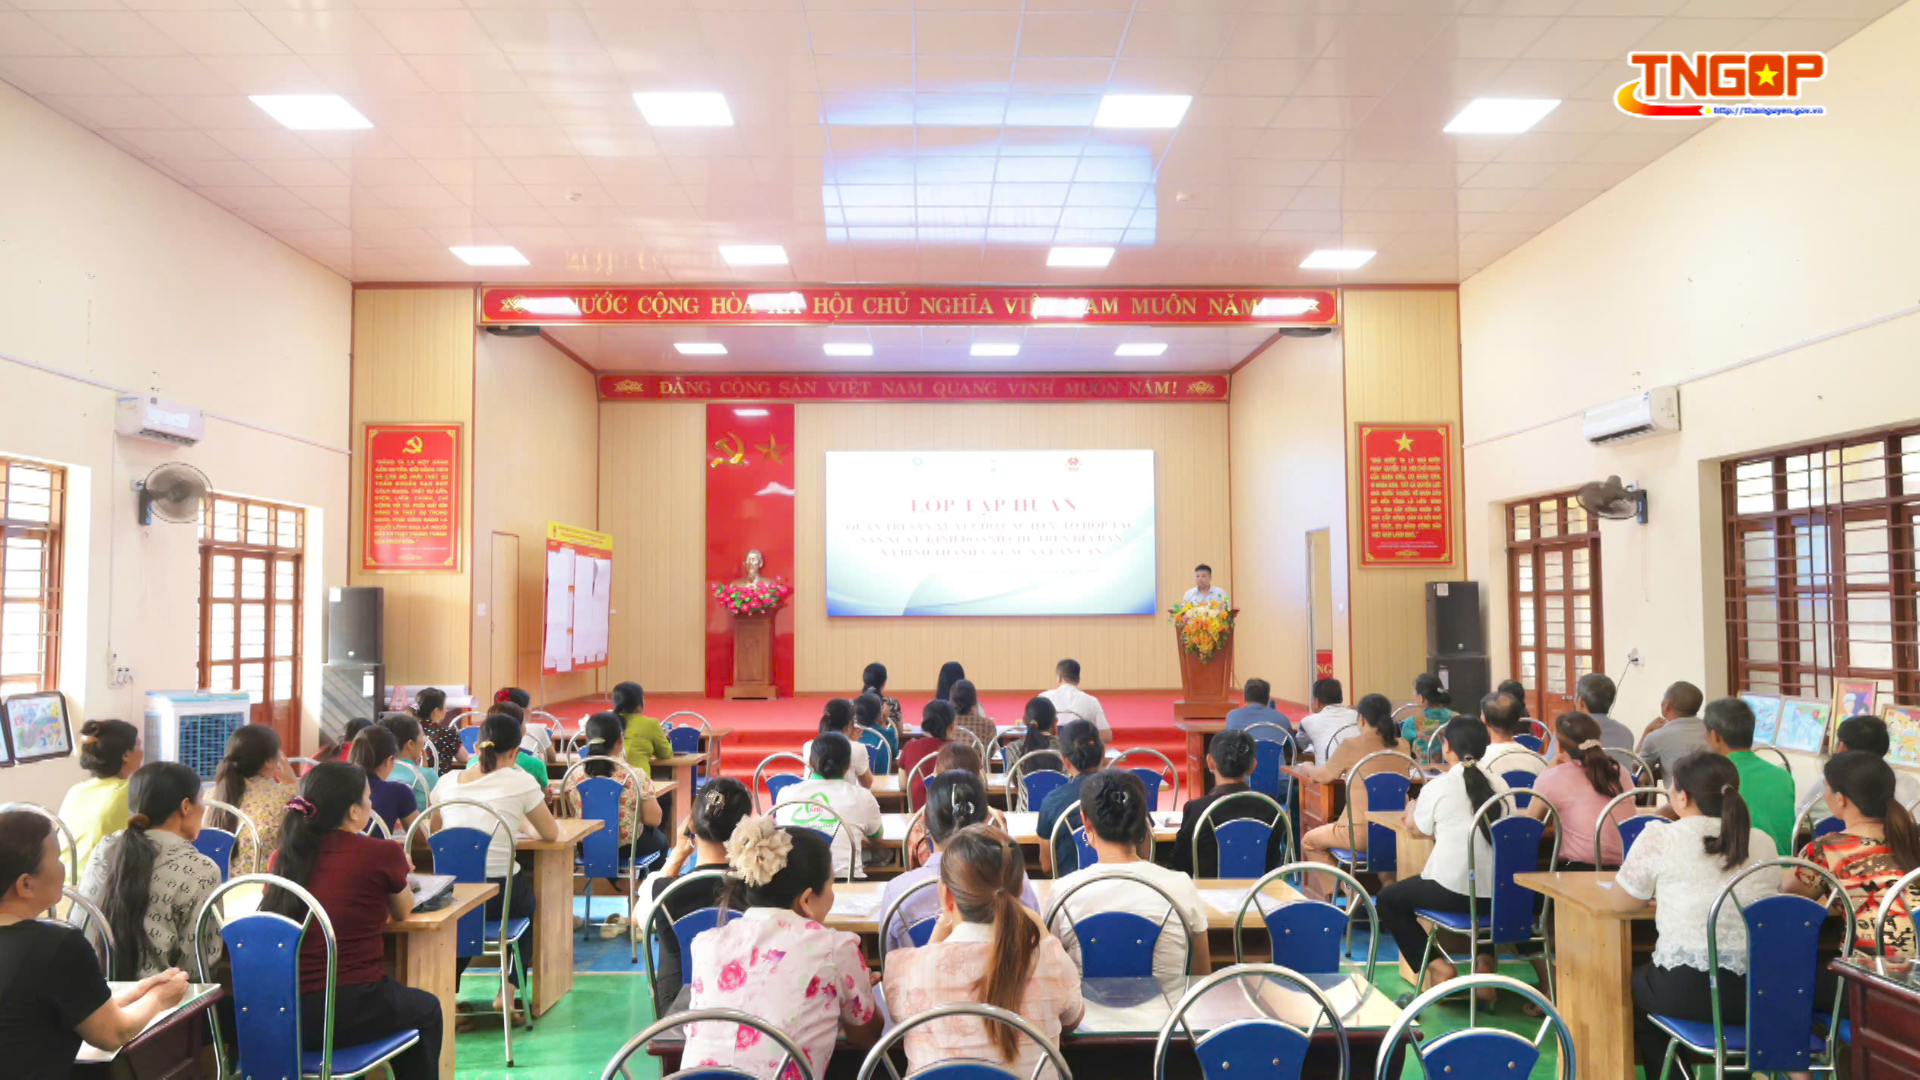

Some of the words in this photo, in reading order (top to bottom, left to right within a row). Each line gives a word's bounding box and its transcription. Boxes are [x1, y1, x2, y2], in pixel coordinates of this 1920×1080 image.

[638, 291, 700, 318] CỘNG
[812, 291, 854, 318] HỘI
[862, 291, 910, 315] CHỦ
[919, 293, 994, 315] NGHĨA
[1066, 297, 1119, 315] AM
[1131, 293, 1197, 315] MUÔN
[659, 376, 711, 395] ĐẢNG
[778, 376, 817, 395] SẢN
[827, 377, 871, 397] VIỆT
[881, 381, 923, 395] NAM
[933, 381, 997, 398] QUANG
[1008, 380, 1054, 395] VINH
